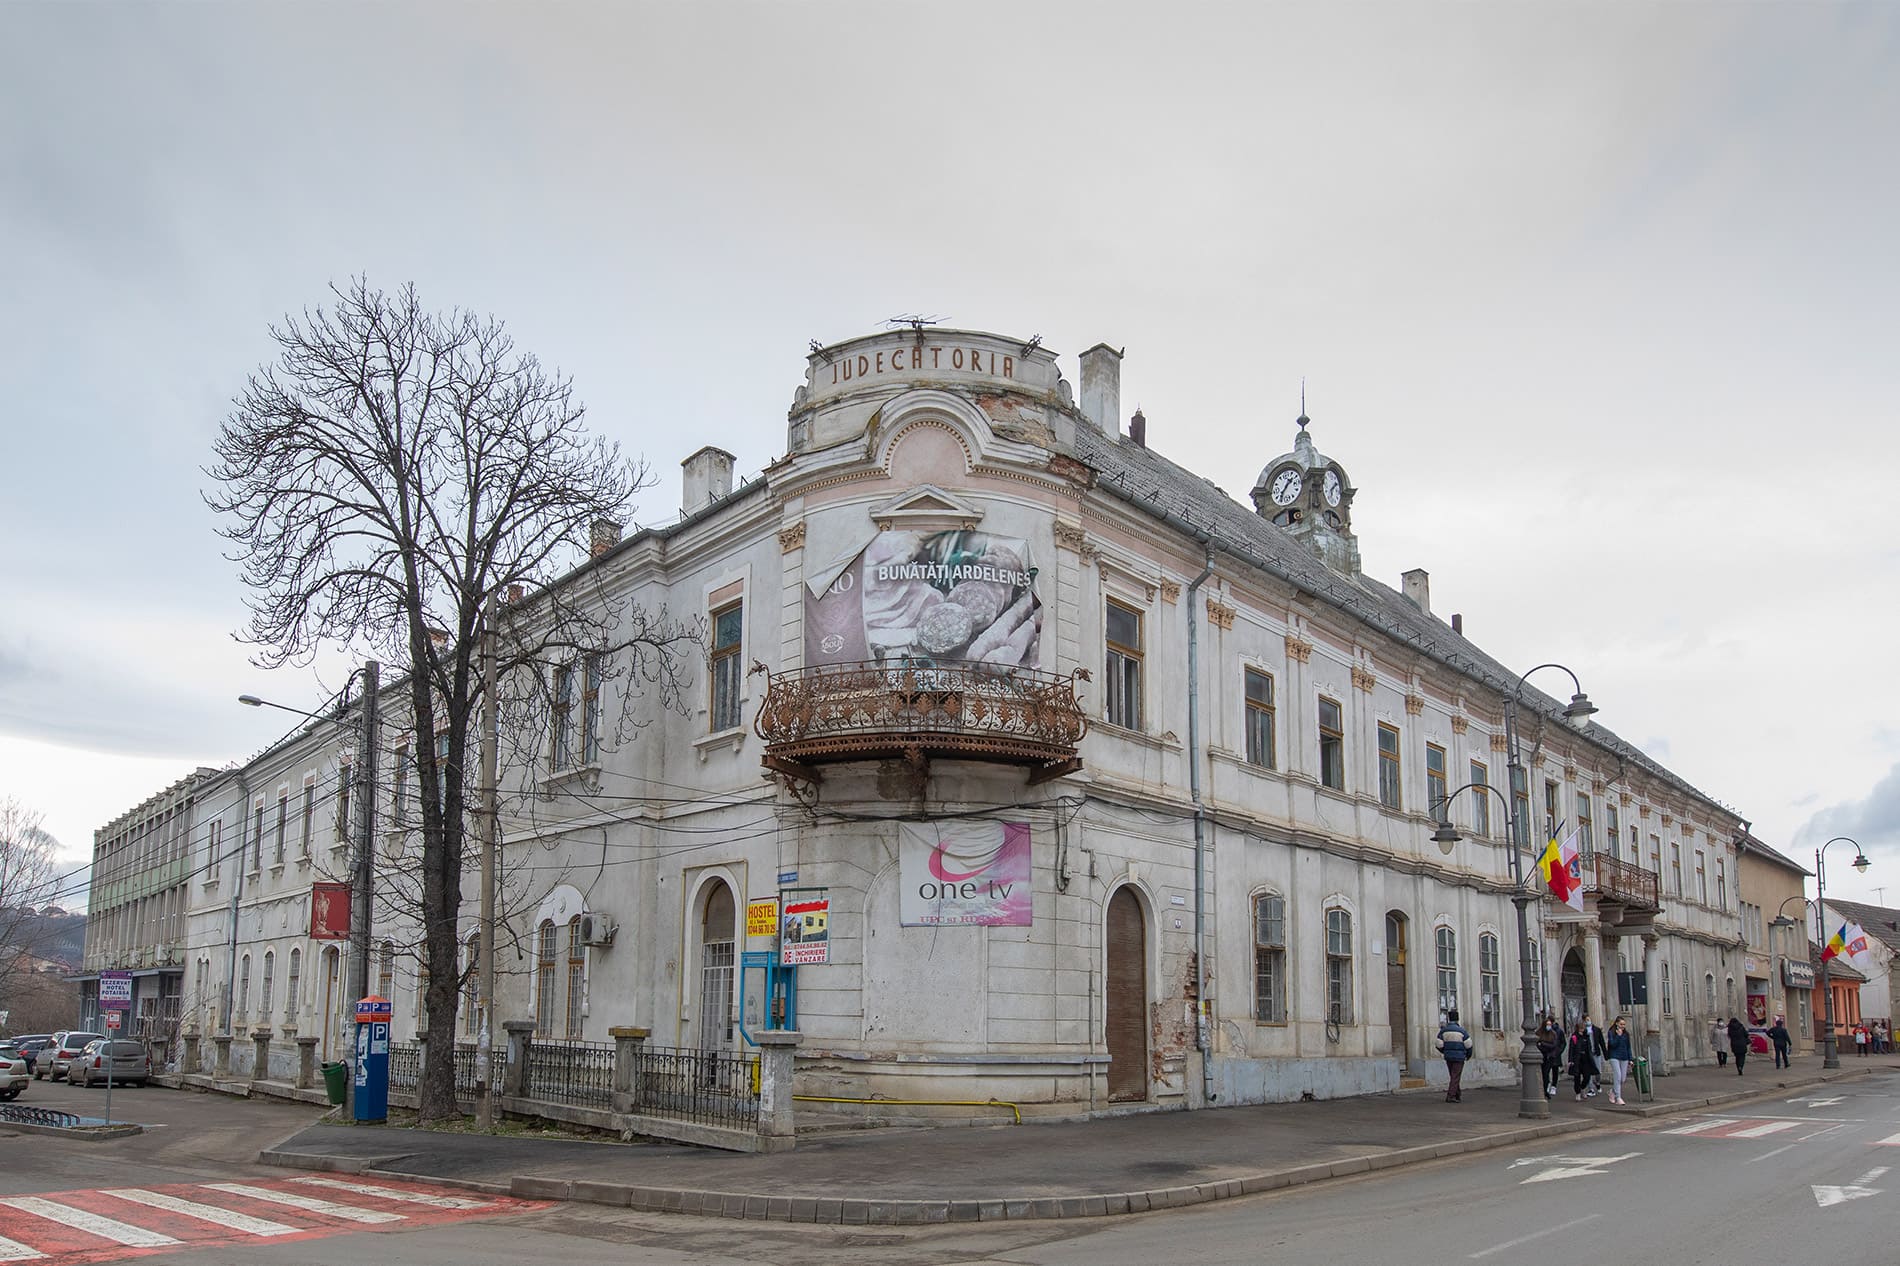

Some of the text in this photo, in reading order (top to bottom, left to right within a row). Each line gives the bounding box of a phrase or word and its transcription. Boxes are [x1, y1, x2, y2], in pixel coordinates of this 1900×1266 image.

[919, 879, 1013, 900] one tv
[748, 904, 776, 919] HOSTEL
[372, 1003, 380, 1012] P
[375, 1025, 386, 1040] P
